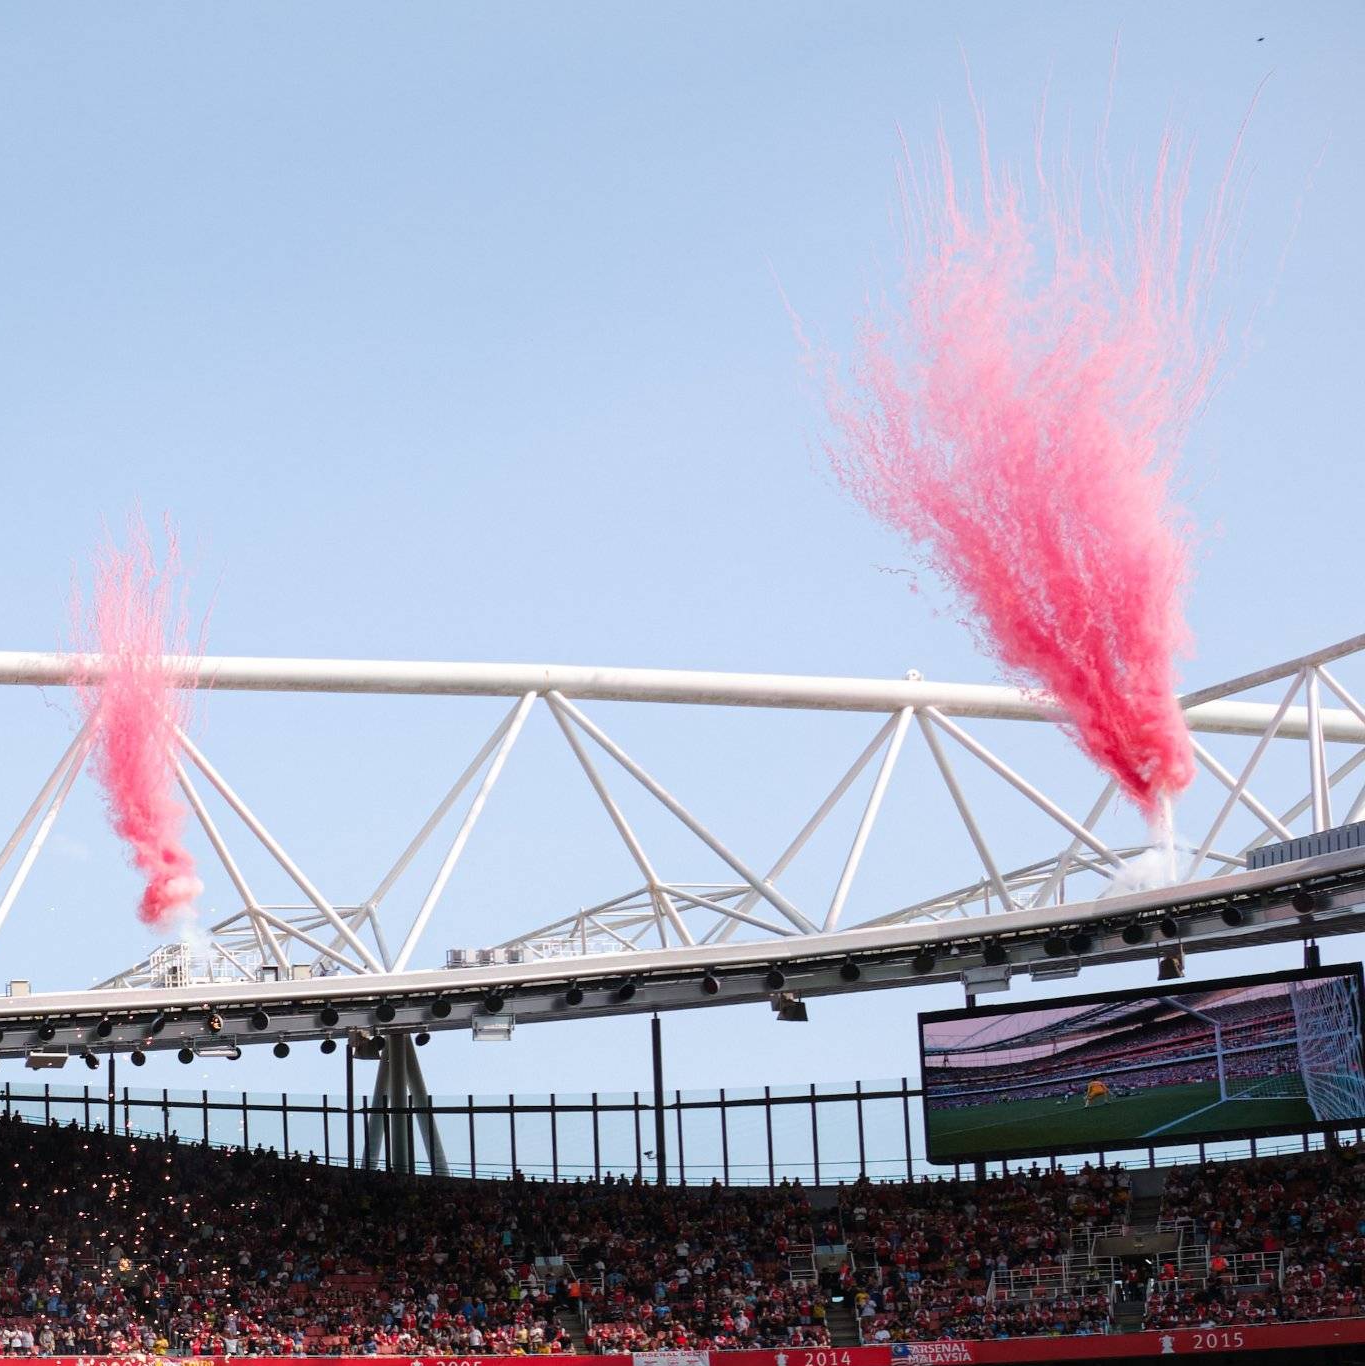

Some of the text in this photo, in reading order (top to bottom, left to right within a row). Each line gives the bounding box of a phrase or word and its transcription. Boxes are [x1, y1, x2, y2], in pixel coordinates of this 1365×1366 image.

[1193, 1333, 1244, 1350] 2015
[912, 1343, 967, 1354] ARSENAL
[909, 1353, 971, 1364] MALAYSIA
